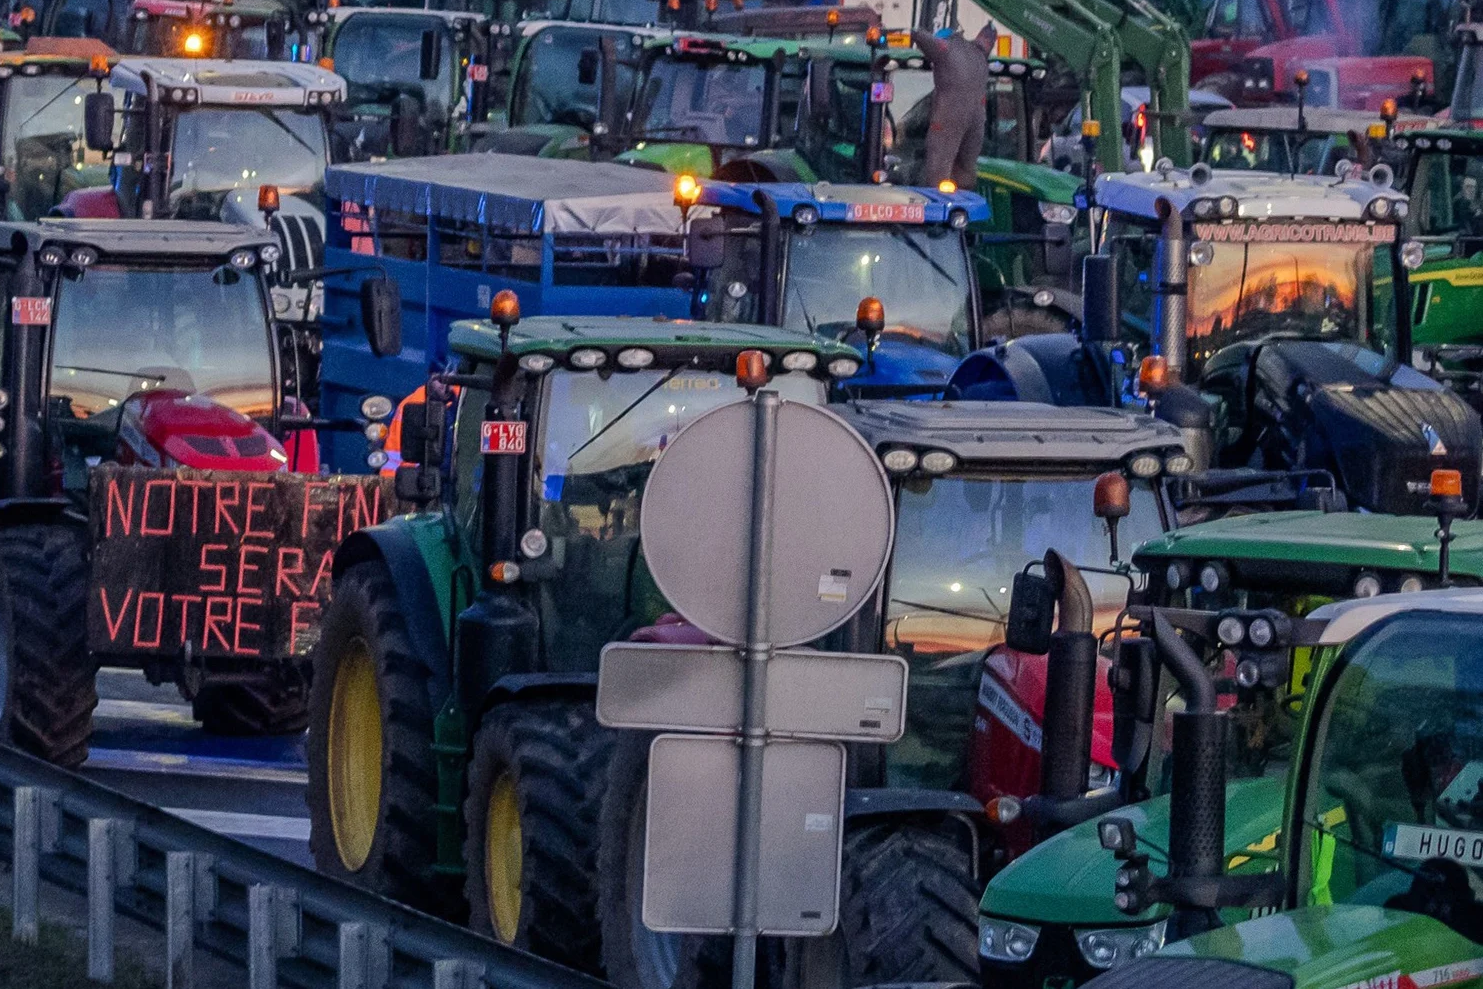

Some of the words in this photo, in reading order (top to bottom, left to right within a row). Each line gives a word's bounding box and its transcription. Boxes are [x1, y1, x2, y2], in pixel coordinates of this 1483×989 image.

[105, 480, 276, 539] NOTRE
[302, 481, 380, 542] FIN
[199, 544, 334, 596] SERA
[101, 587, 264, 656] VOTRE
[1419, 831, 1483, 860] HUGO
